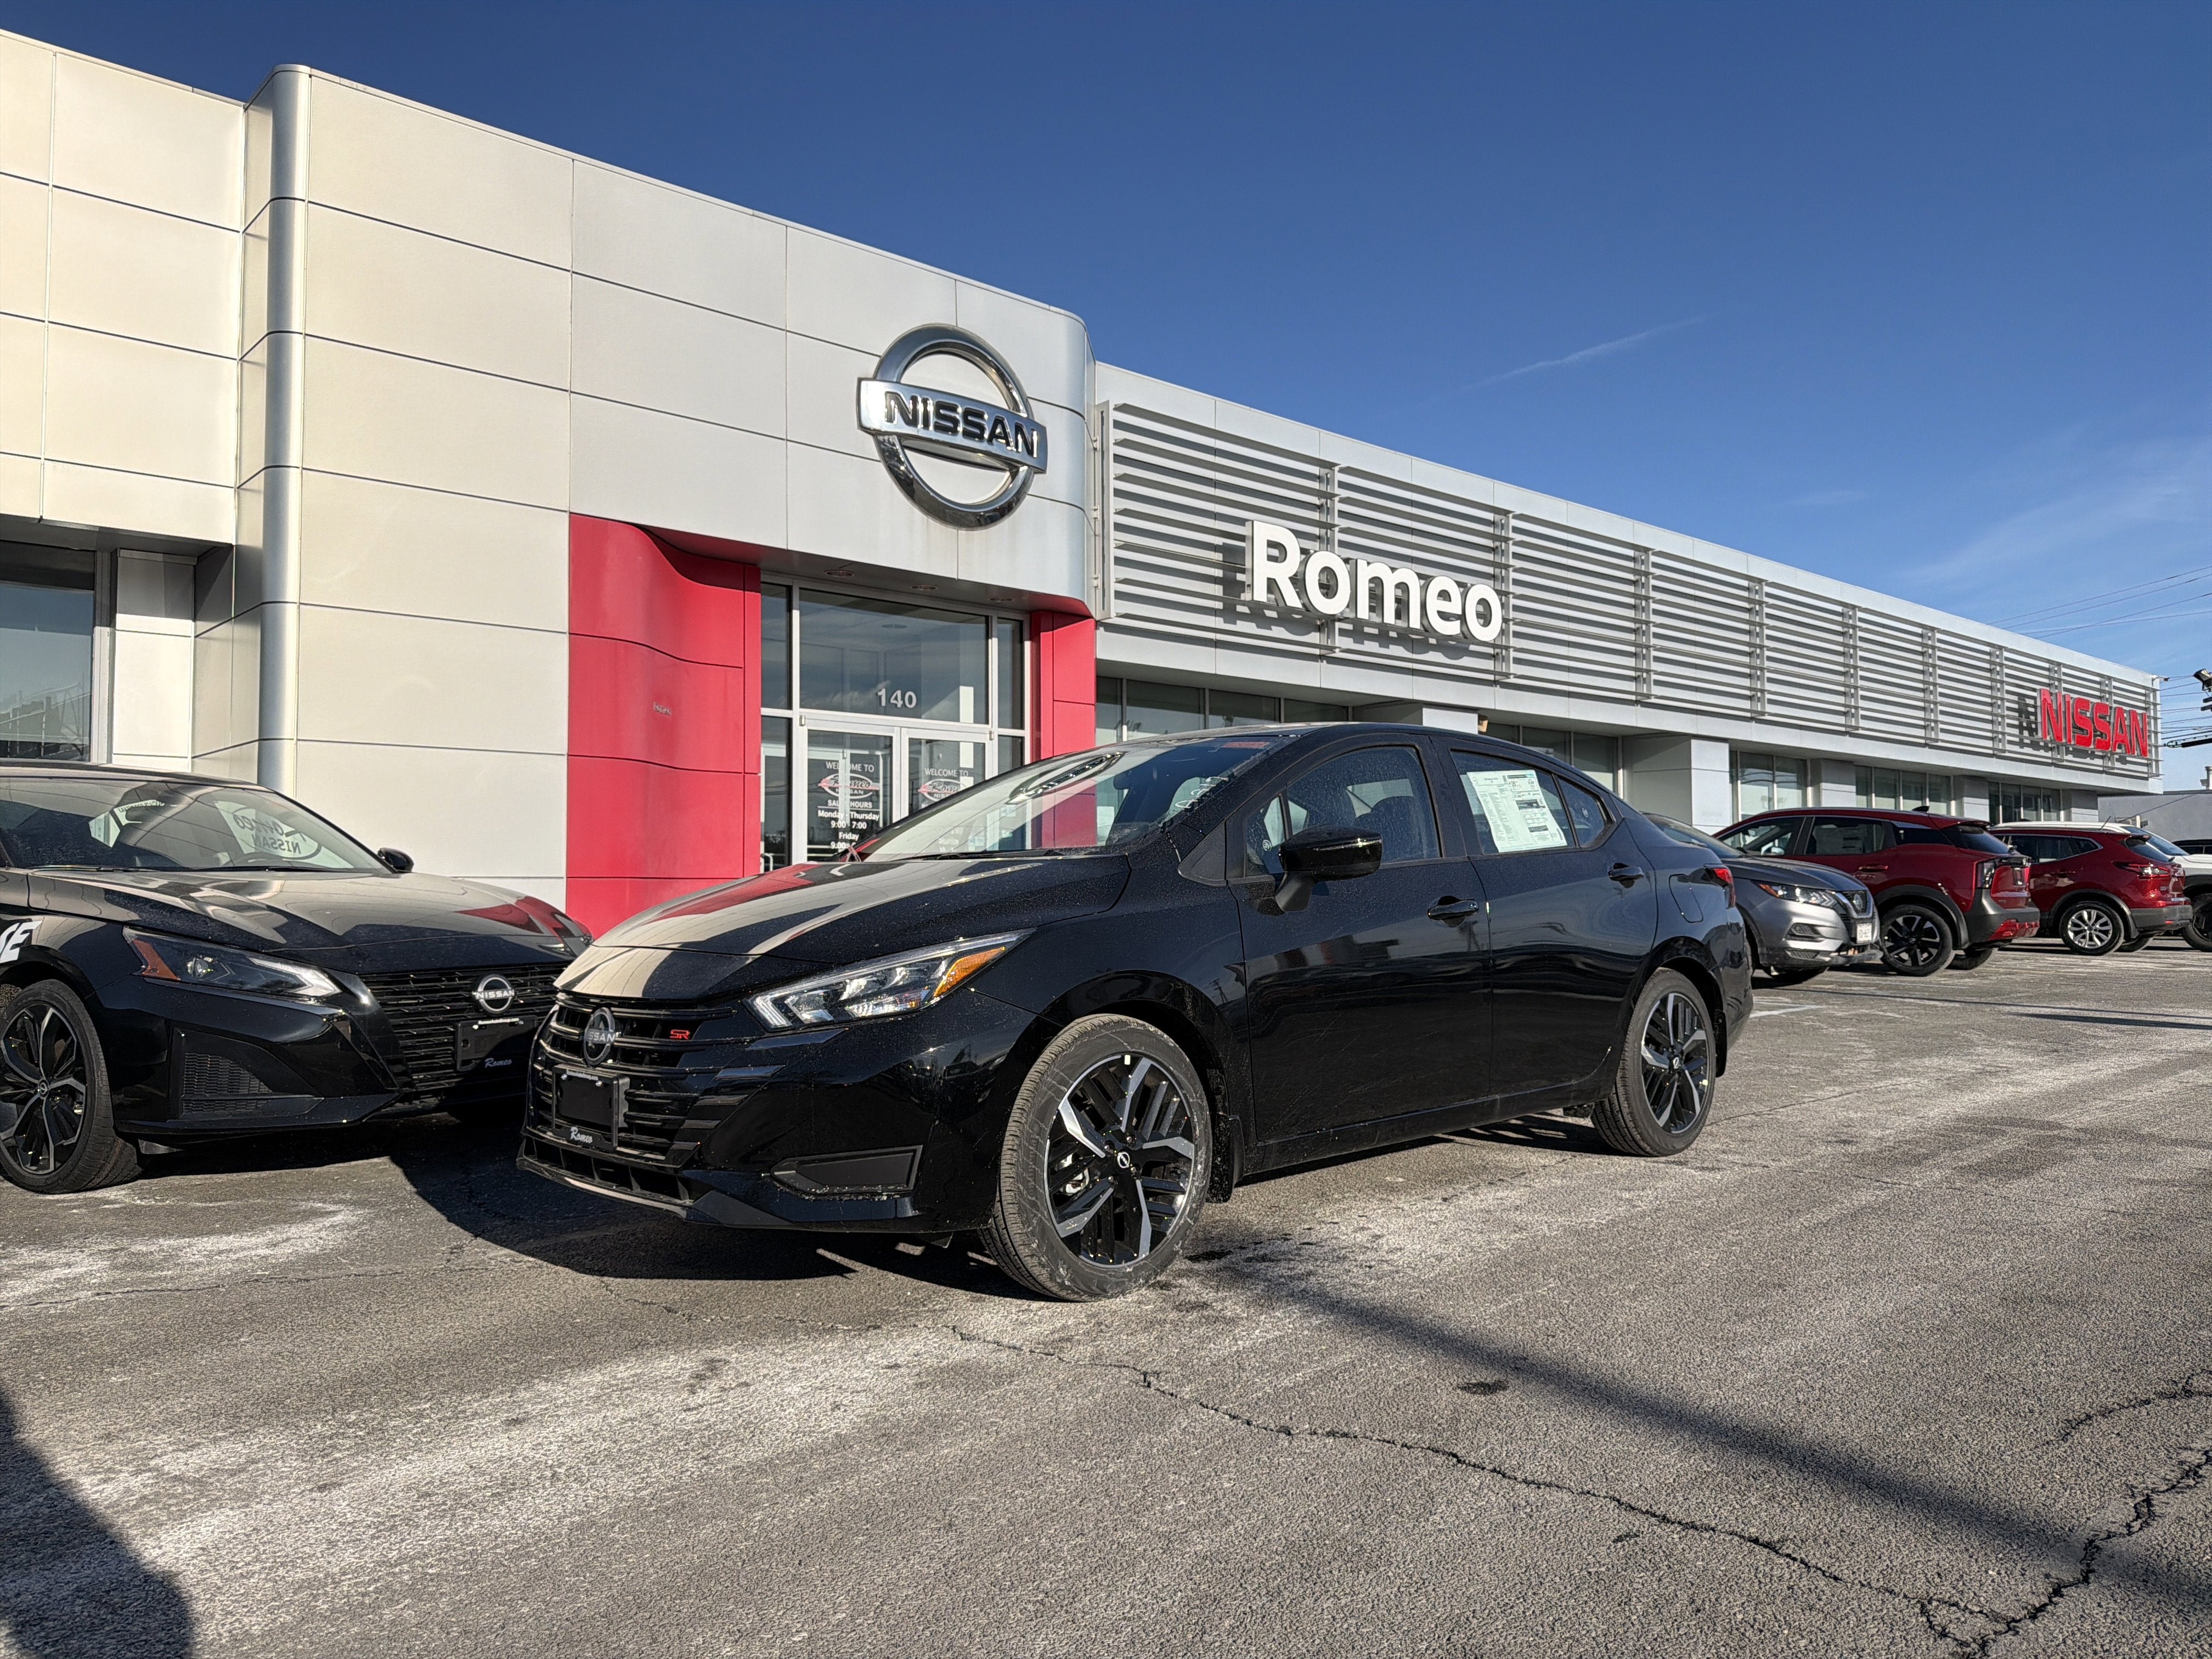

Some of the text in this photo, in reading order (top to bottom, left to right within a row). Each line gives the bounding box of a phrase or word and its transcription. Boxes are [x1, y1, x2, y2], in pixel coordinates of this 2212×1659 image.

[884, 391, 1039, 459] NISSAN
[1246, 520, 1502, 642] Romeo
[878, 688, 917, 708] 140
[2039, 689, 2148, 758] NISSAN
[863, 764, 874, 772] TO
[925, 768, 957, 777] WELCOME
[817, 809, 845, 820] Monday
[850, 811, 879, 821] Thursday
[831, 820, 867, 829] 9:00 7:00
[838, 831, 860, 841] Friday
[476, 990, 515, 999] NISSAN
[669, 1029, 690, 1040] SR
[484, 1057, 512, 1068] Romeo
[571, 1126, 593, 1144] Romeo
